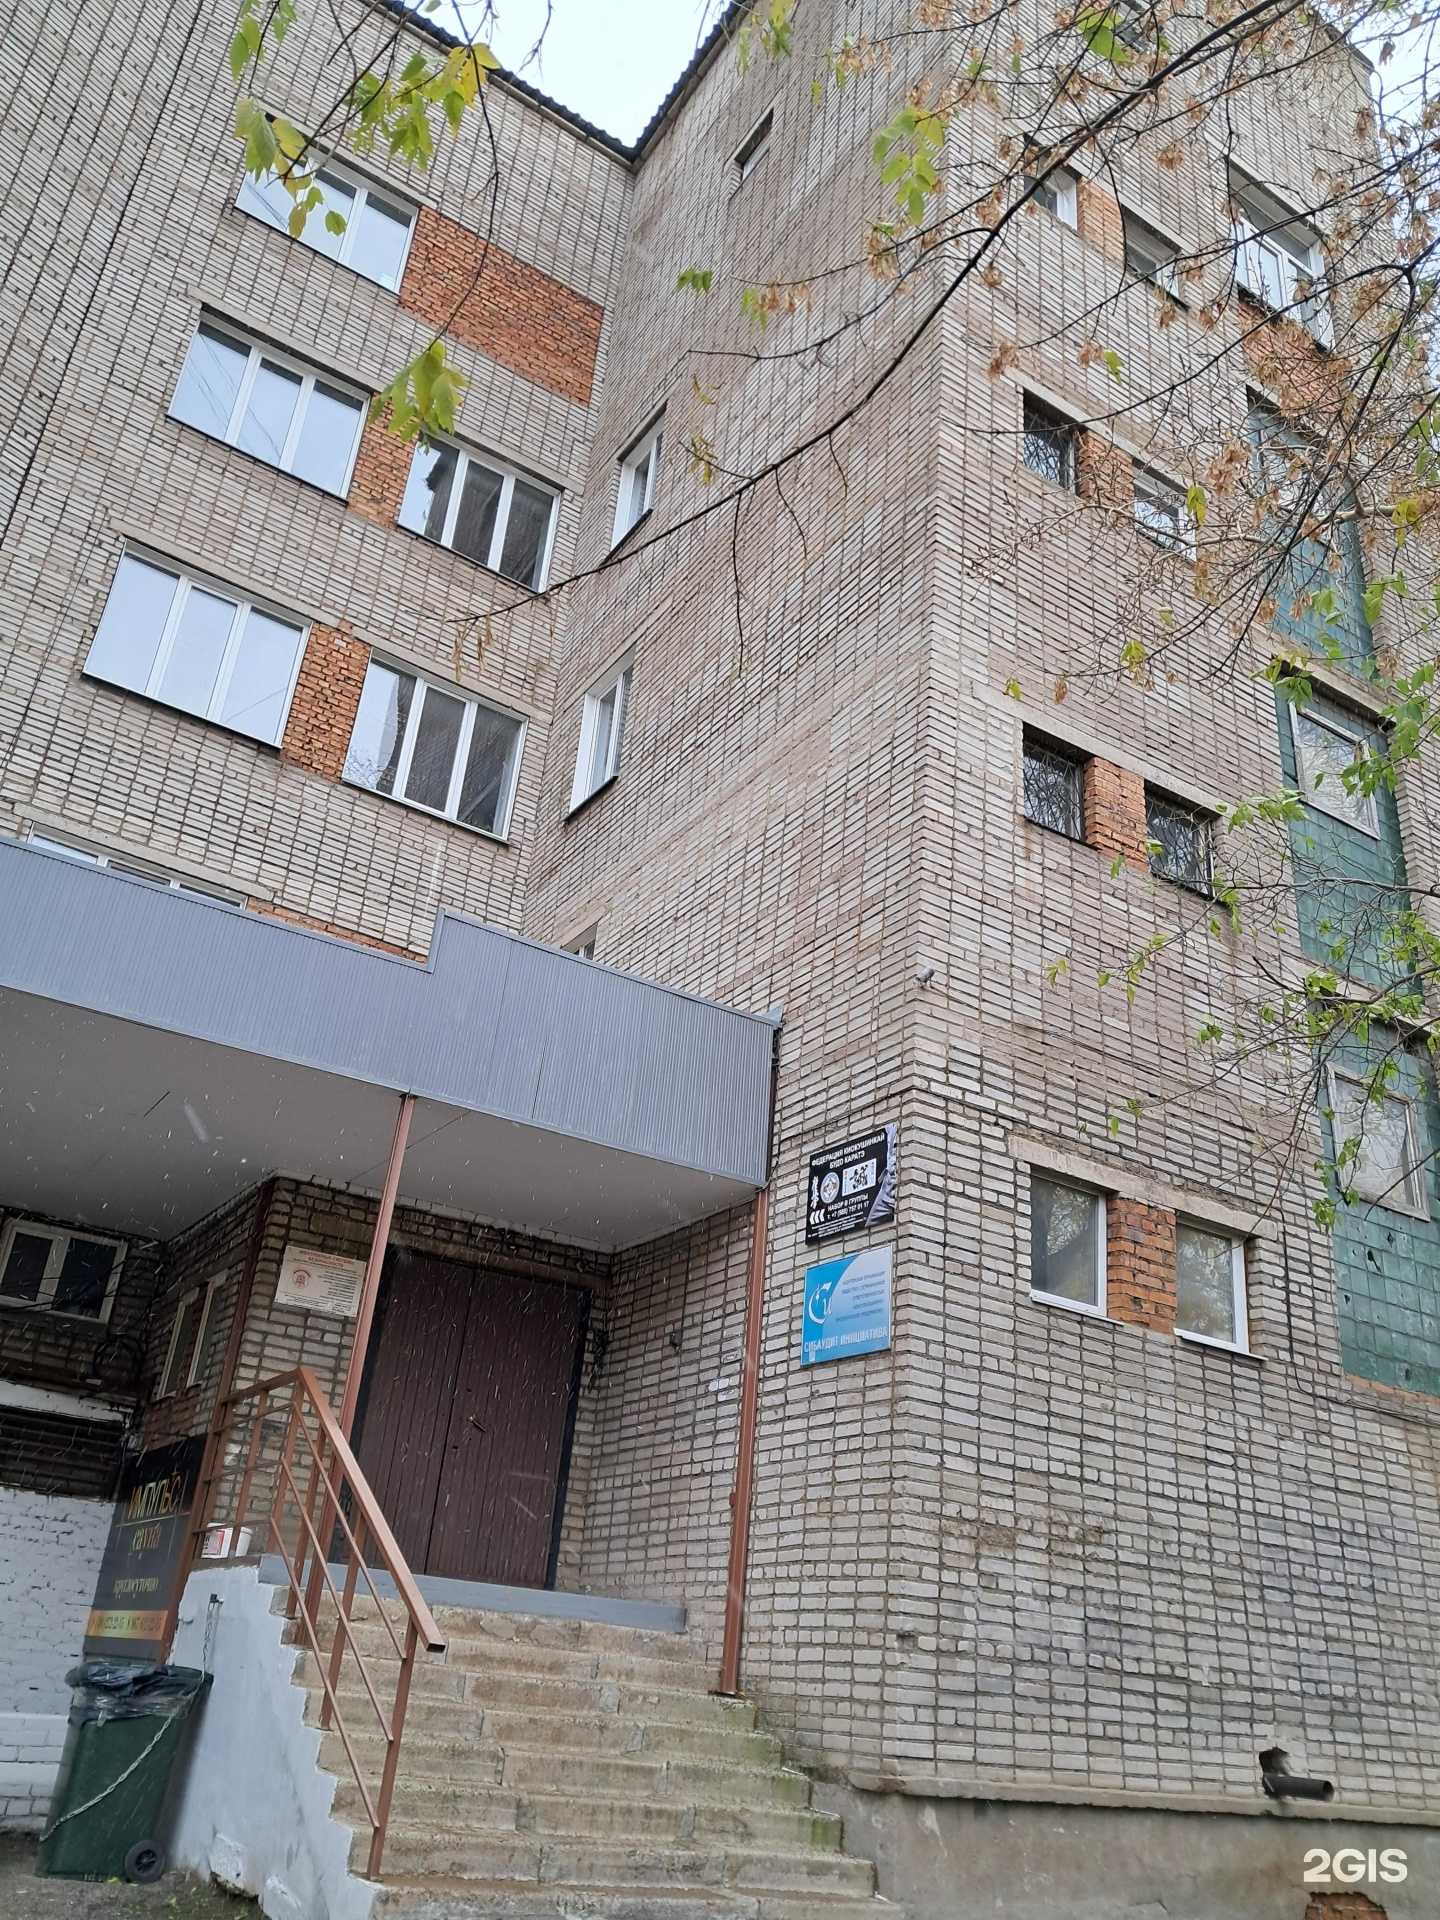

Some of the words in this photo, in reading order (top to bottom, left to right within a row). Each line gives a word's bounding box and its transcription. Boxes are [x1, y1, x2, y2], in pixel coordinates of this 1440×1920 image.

[812, 1148, 843, 1166] ФЕДЕРАЦИЯ
[829, 1158, 843, 1169] БУДО
[845, 1150, 865, 1164] КАРАТЭ
[827, 1202, 844, 1211] НАБОР
[848, 1193, 869, 1205] ГРУППЫ
